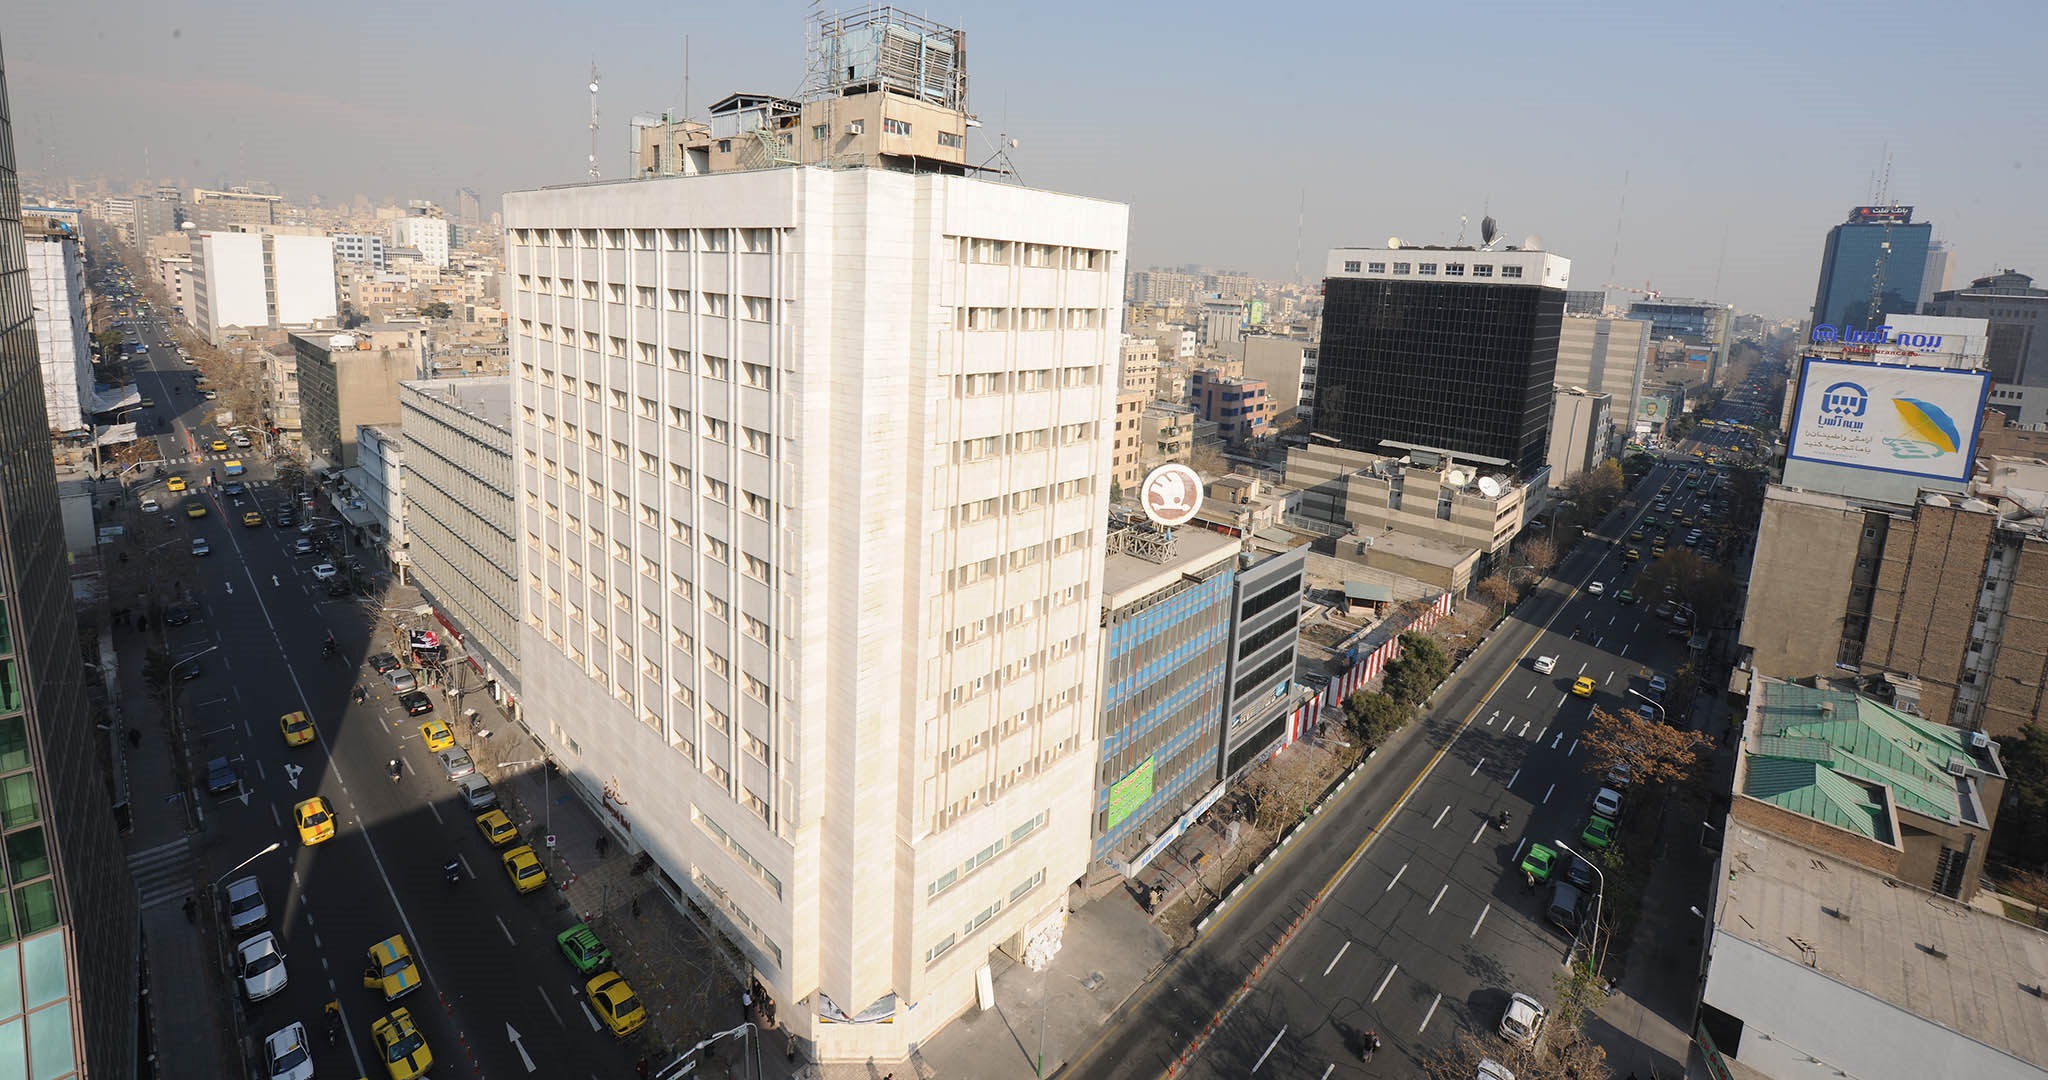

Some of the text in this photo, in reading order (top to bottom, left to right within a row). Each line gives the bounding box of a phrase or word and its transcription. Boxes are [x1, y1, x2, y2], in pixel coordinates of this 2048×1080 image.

[1844, 325, 1942, 353] بیمه آسیا
[1818, 415, 1864, 433] بیمه آسیا
